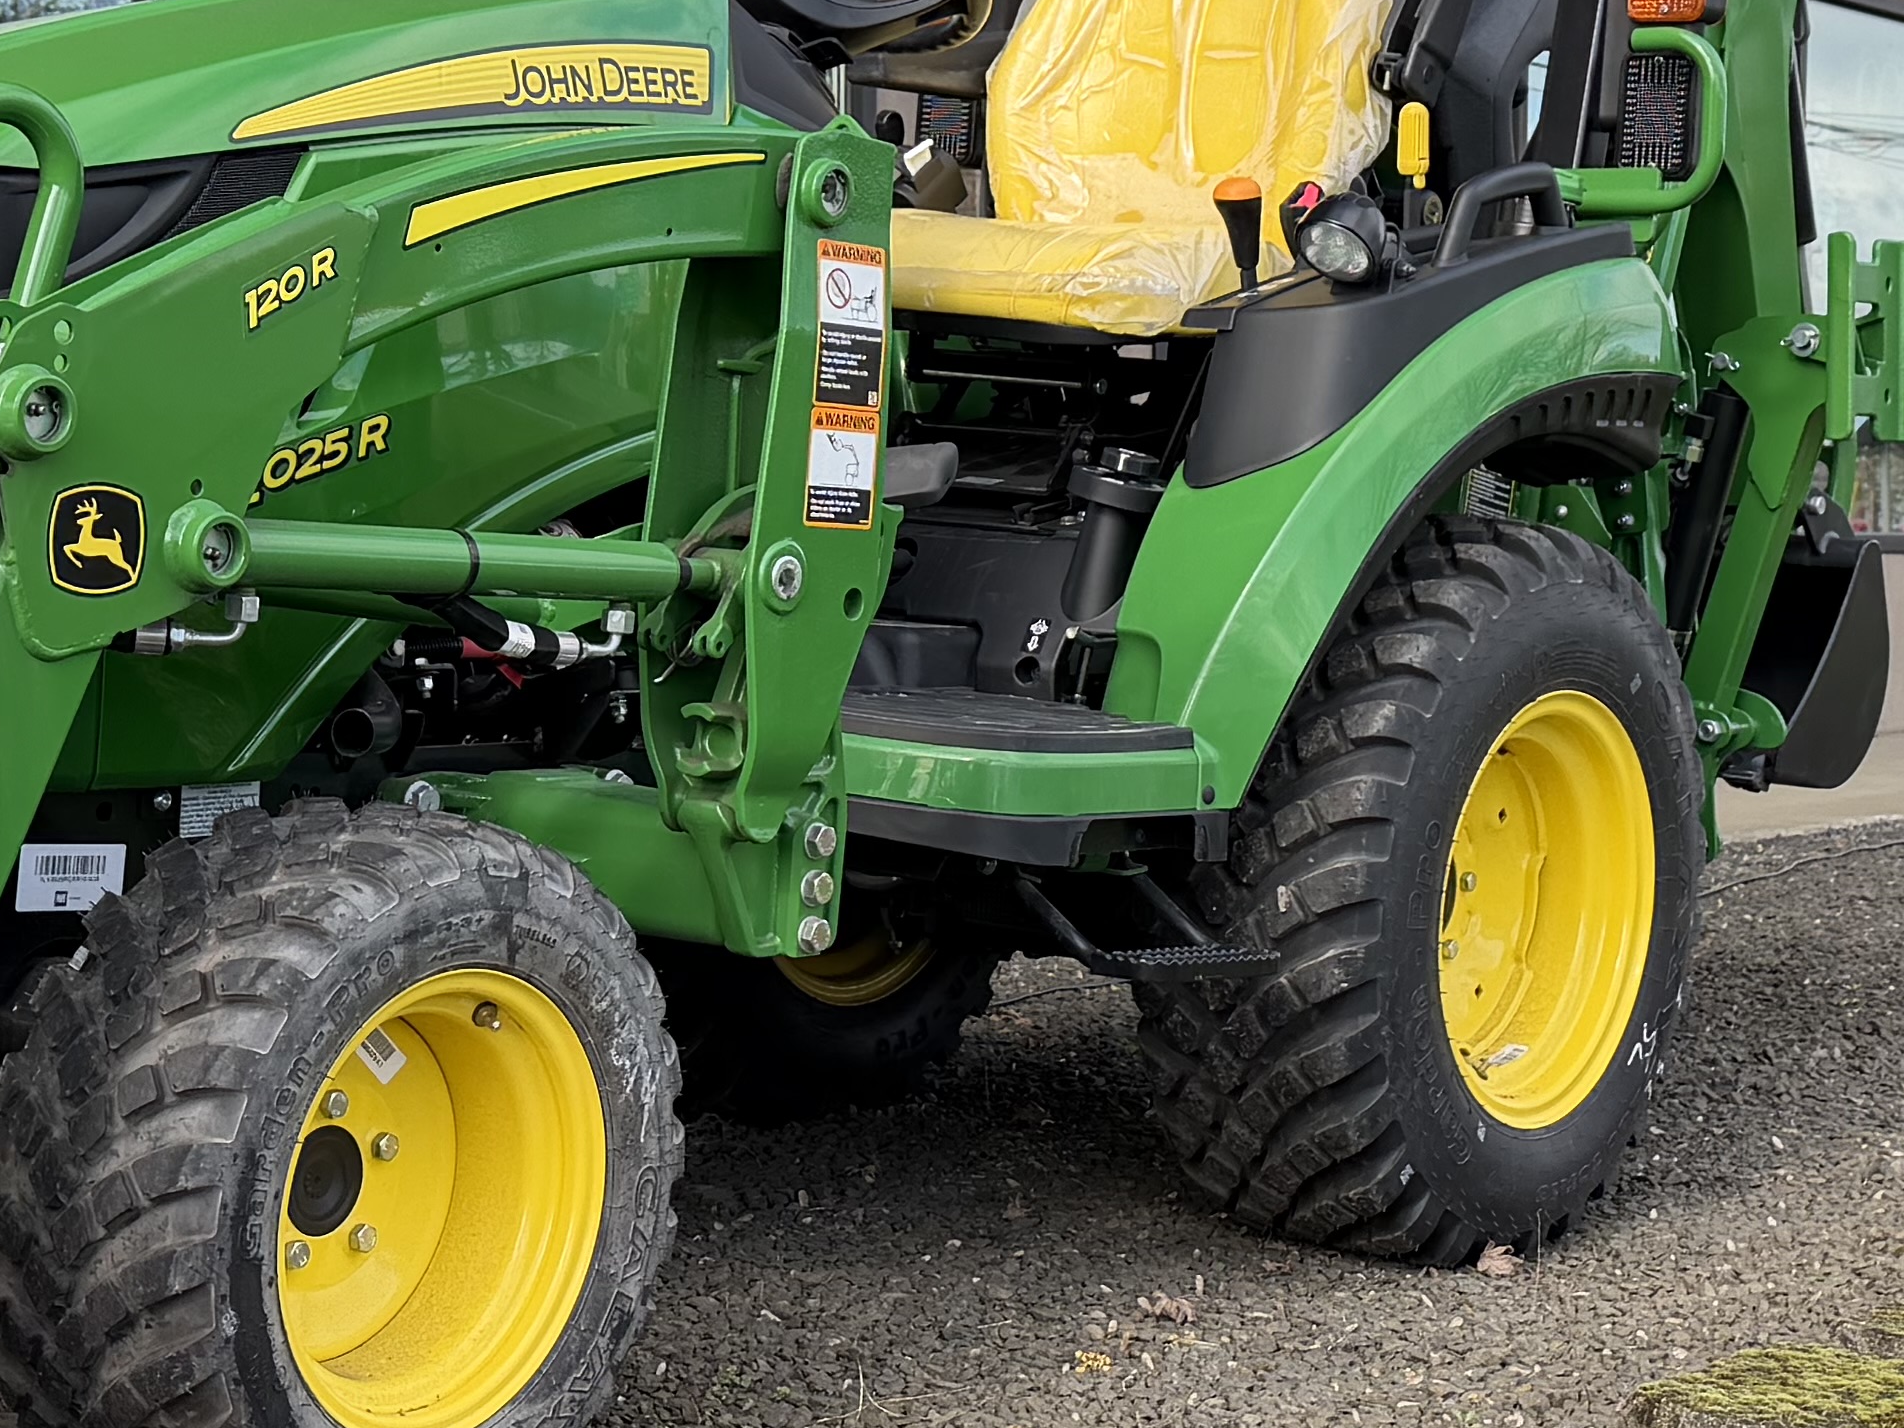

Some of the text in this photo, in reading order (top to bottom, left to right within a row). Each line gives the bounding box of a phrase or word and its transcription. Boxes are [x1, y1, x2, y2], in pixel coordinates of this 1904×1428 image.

[503, 56, 700, 101] JOHN DEERE
[831, 244, 882, 265] WARNING
[824, 411, 876, 431] WARNING
[249, 427, 350, 504] 025
